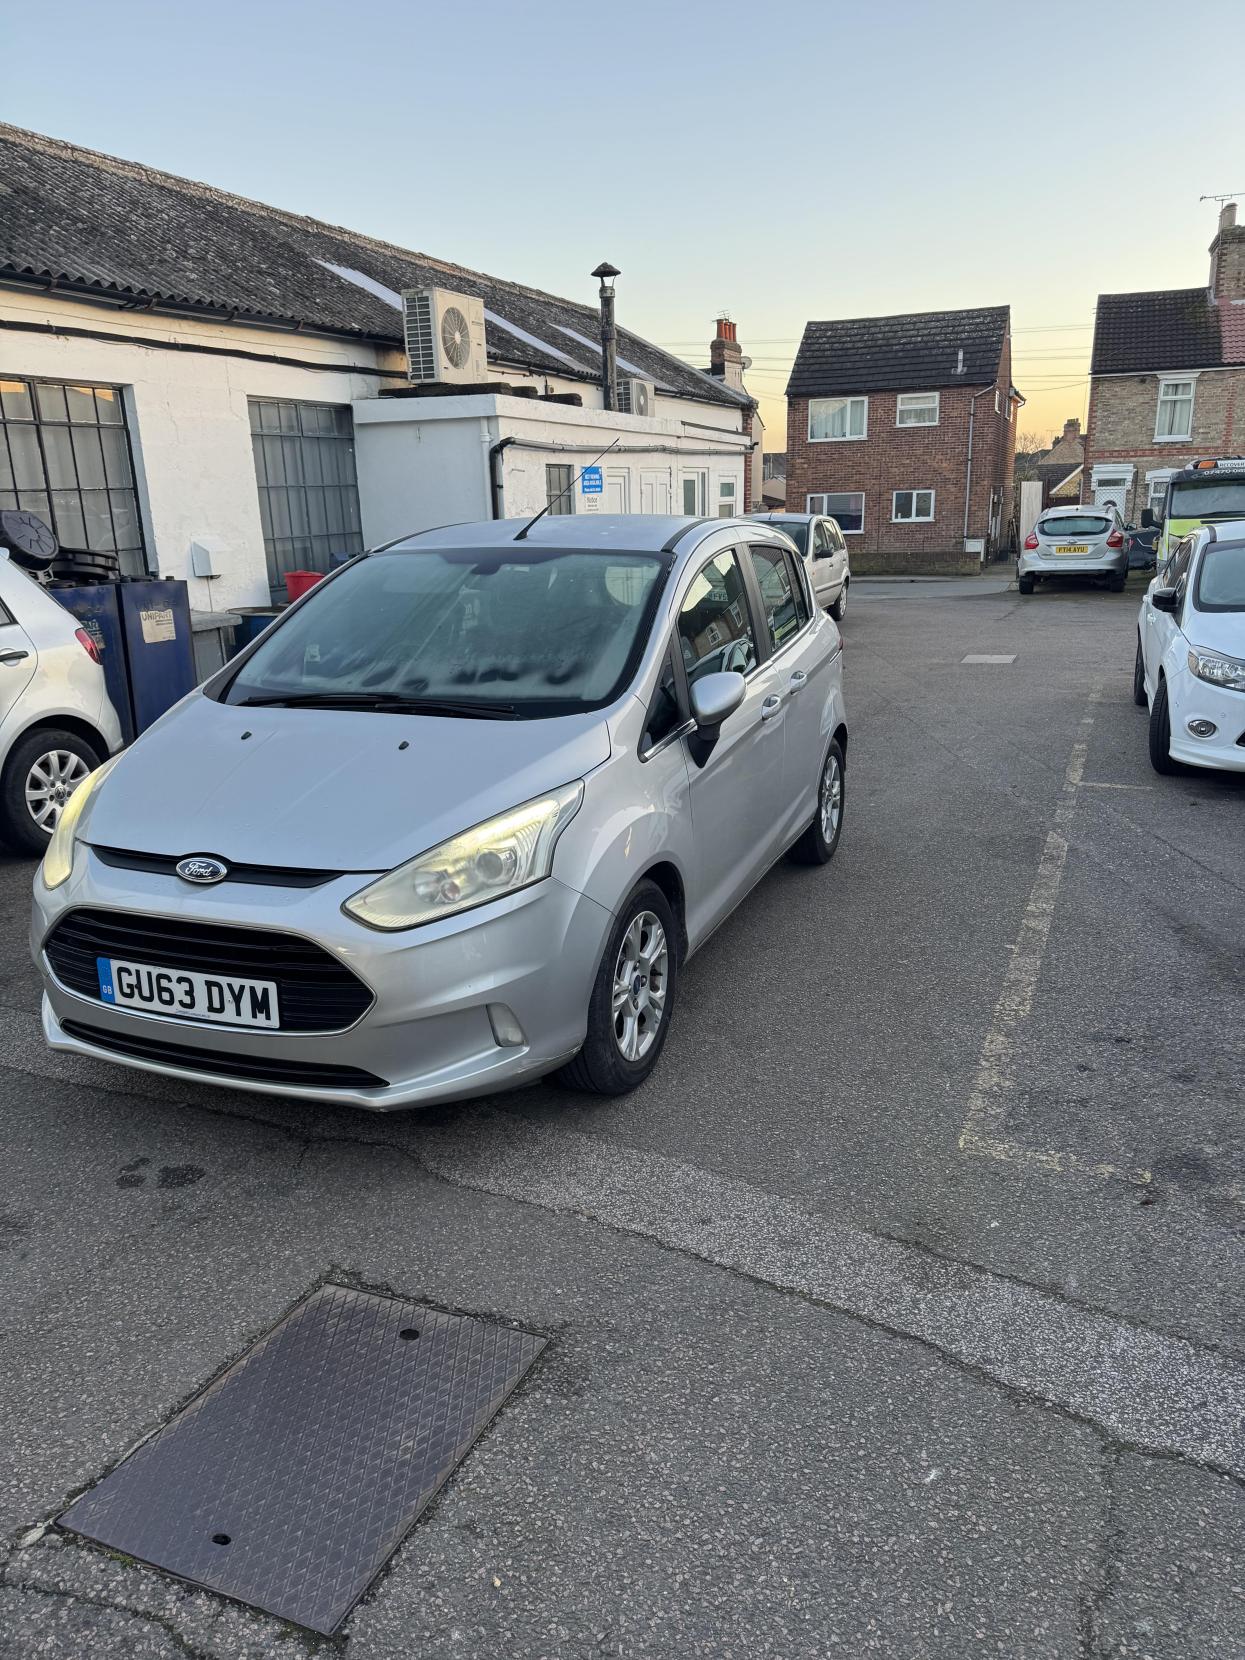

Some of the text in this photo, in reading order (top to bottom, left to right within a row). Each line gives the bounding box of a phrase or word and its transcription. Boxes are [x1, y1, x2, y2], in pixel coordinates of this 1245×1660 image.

[141, 612, 172, 621] UNIPART
[185, 861, 213, 876] Ford
[102, 985, 112, 995] GB
[116, 966, 272, 1022] GU63 DYM
